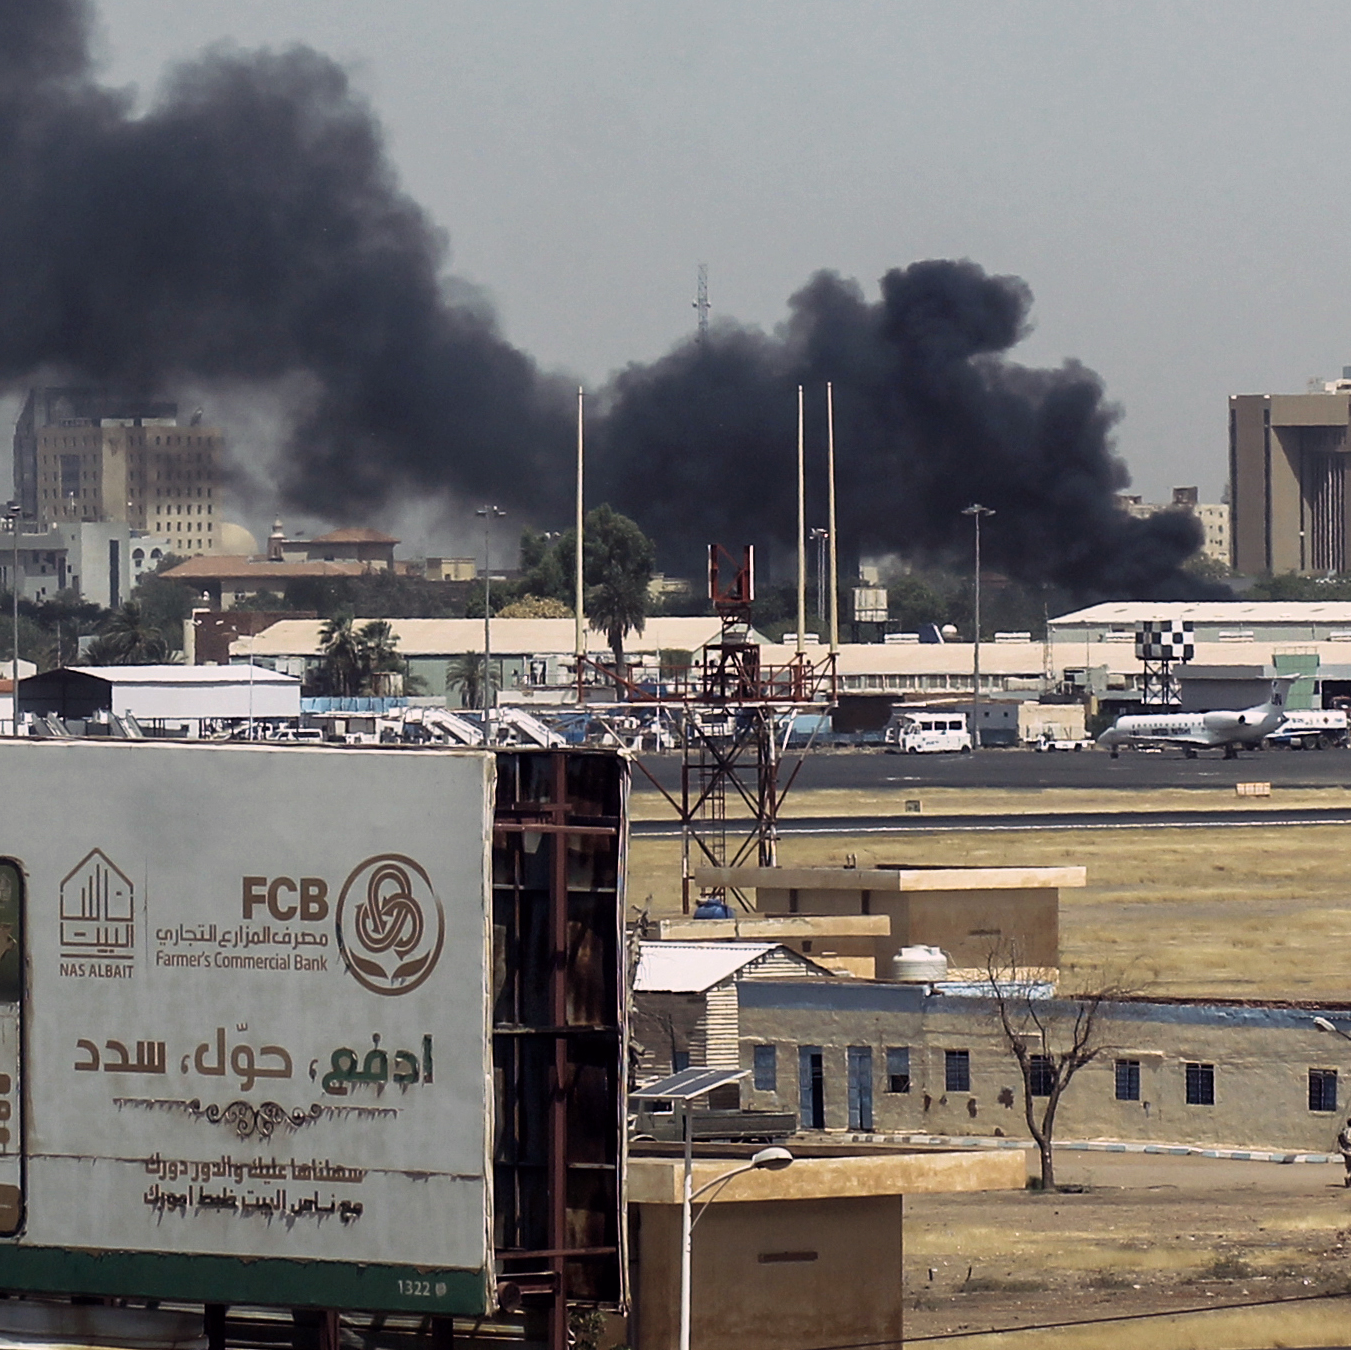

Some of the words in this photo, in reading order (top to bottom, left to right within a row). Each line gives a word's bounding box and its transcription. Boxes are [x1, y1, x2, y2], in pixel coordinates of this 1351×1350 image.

[242, 876, 329, 921] FCB
[156, 924, 217, 947] التجاري
[218, 925, 271, 949] المزارع
[272, 927, 329, 950] مصرف
[60, 963, 86, 978] NAS
[88, 964, 135, 979] ALBAIT
[156, 951, 211, 968] Farmer's
[214, 952, 291, 971] Commercial
[295, 954, 329, 972] Bank
[75, 1038, 167, 1074] سدد
[398, 1279, 431, 1296] 1322
